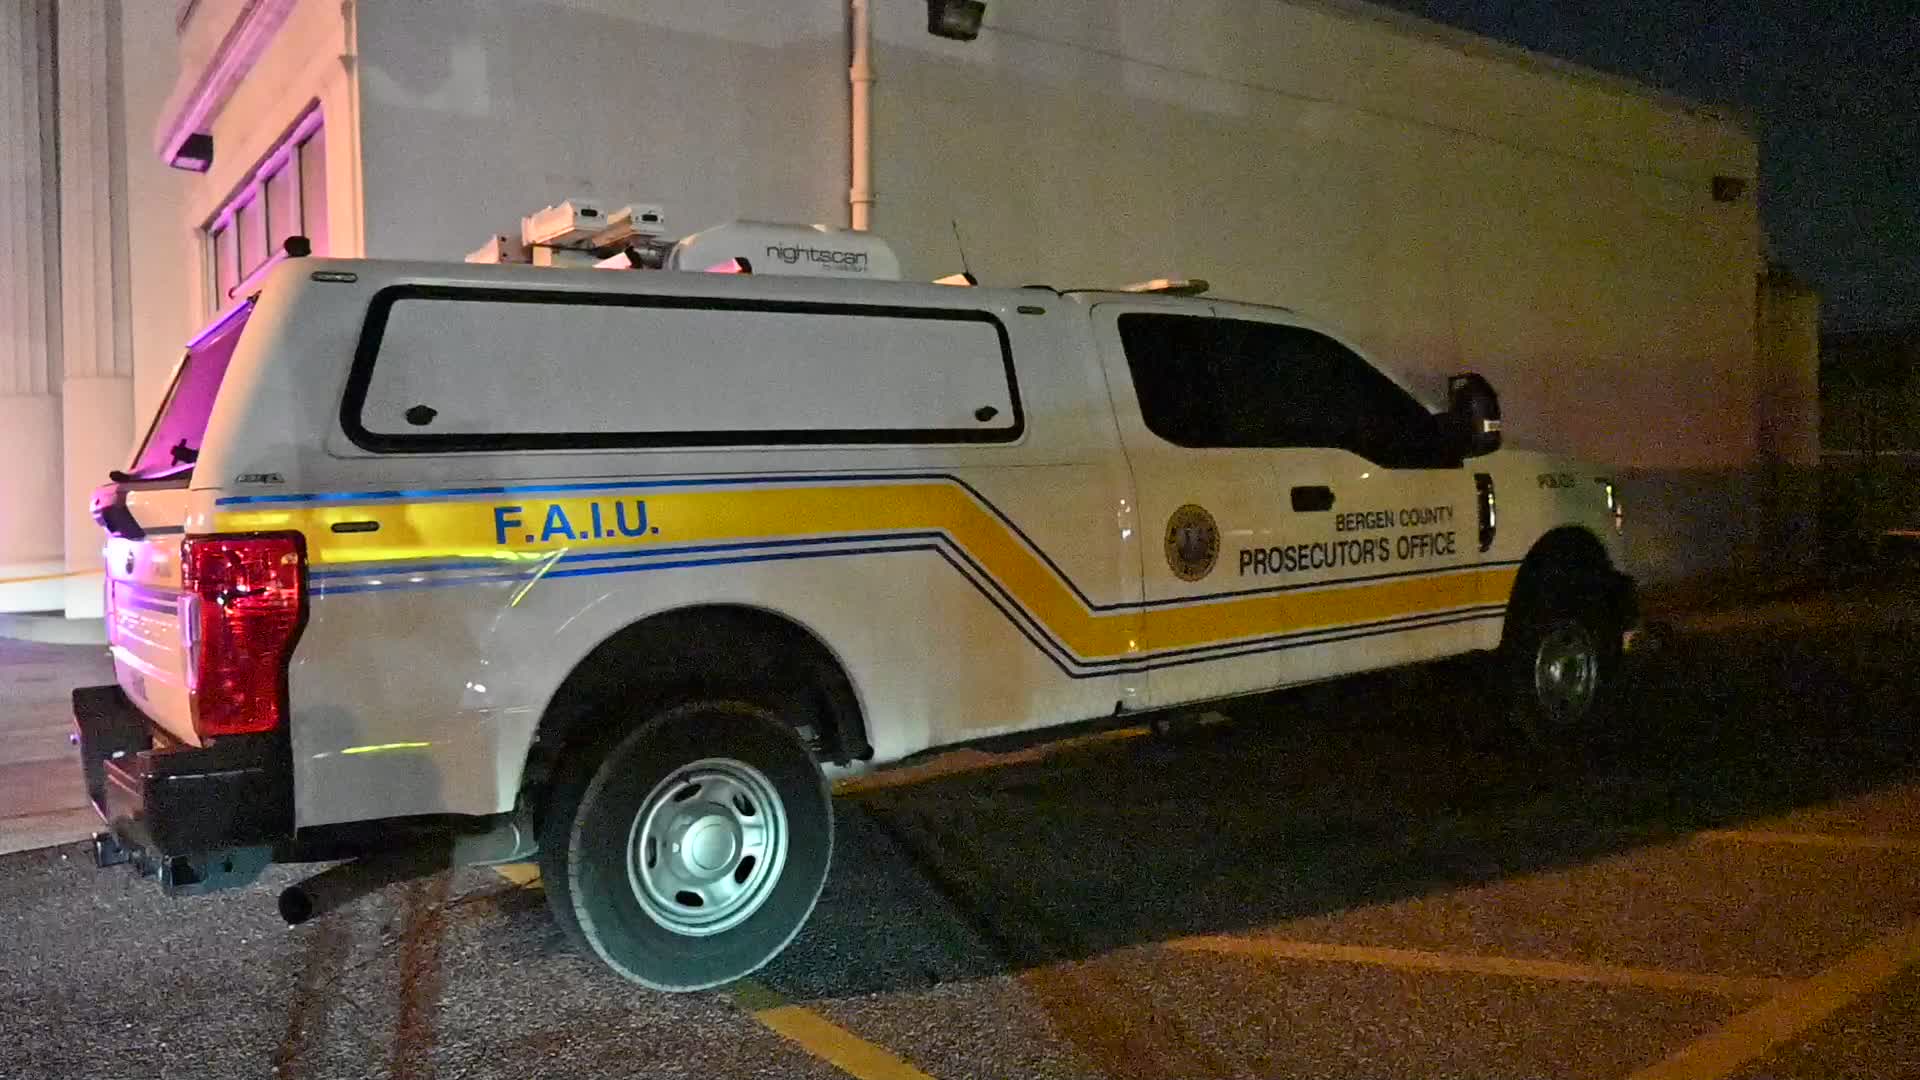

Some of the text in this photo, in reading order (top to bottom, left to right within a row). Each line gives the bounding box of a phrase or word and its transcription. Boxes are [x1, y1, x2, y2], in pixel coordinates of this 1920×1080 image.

[766, 244, 868, 265] nightscan
[493, 499, 659, 545] F.A.I.U.
[1335, 505, 1454, 532] BERGEN COUNTY
[1239, 537, 1391, 577] PROSECUTOR'S
[1396, 531, 1456, 560] OFFICE
